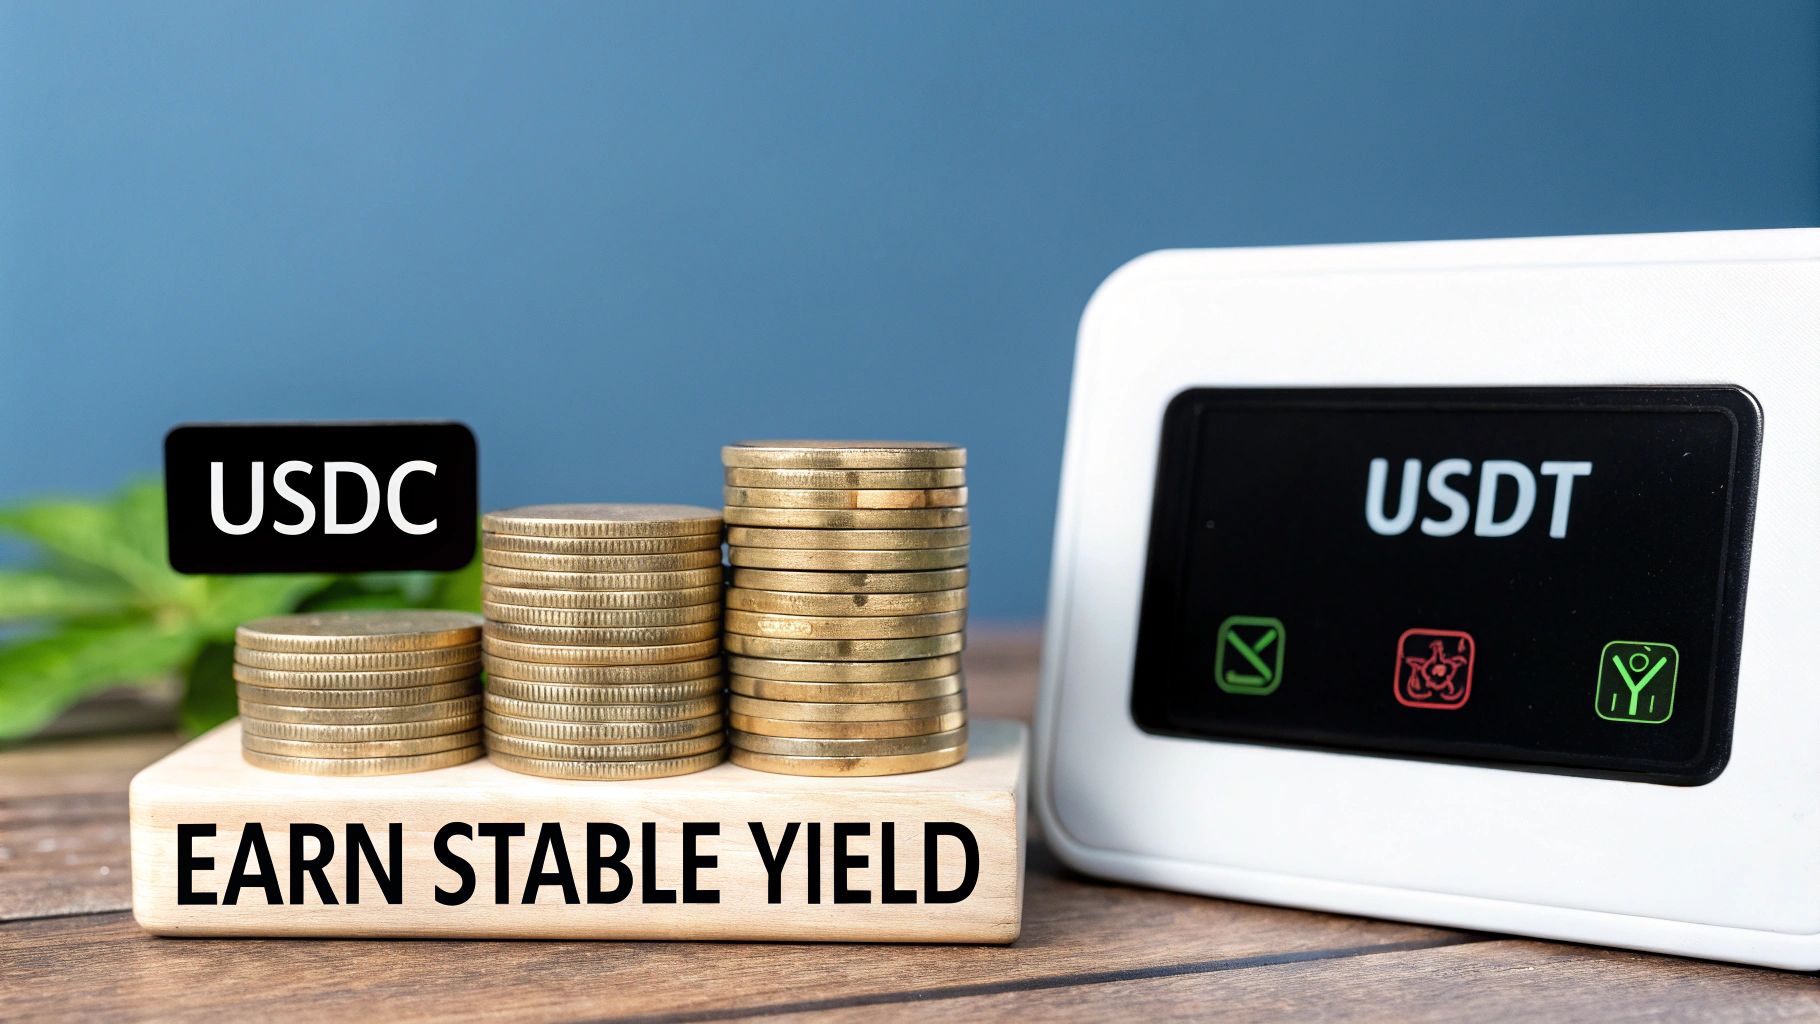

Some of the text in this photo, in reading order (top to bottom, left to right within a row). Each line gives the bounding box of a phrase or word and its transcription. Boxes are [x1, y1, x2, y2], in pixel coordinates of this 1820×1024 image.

[210, 459, 438, 536] USDC
[1365, 458, 1593, 539] USDT
[177, 821, 981, 907] EARN STABLE YIELD
